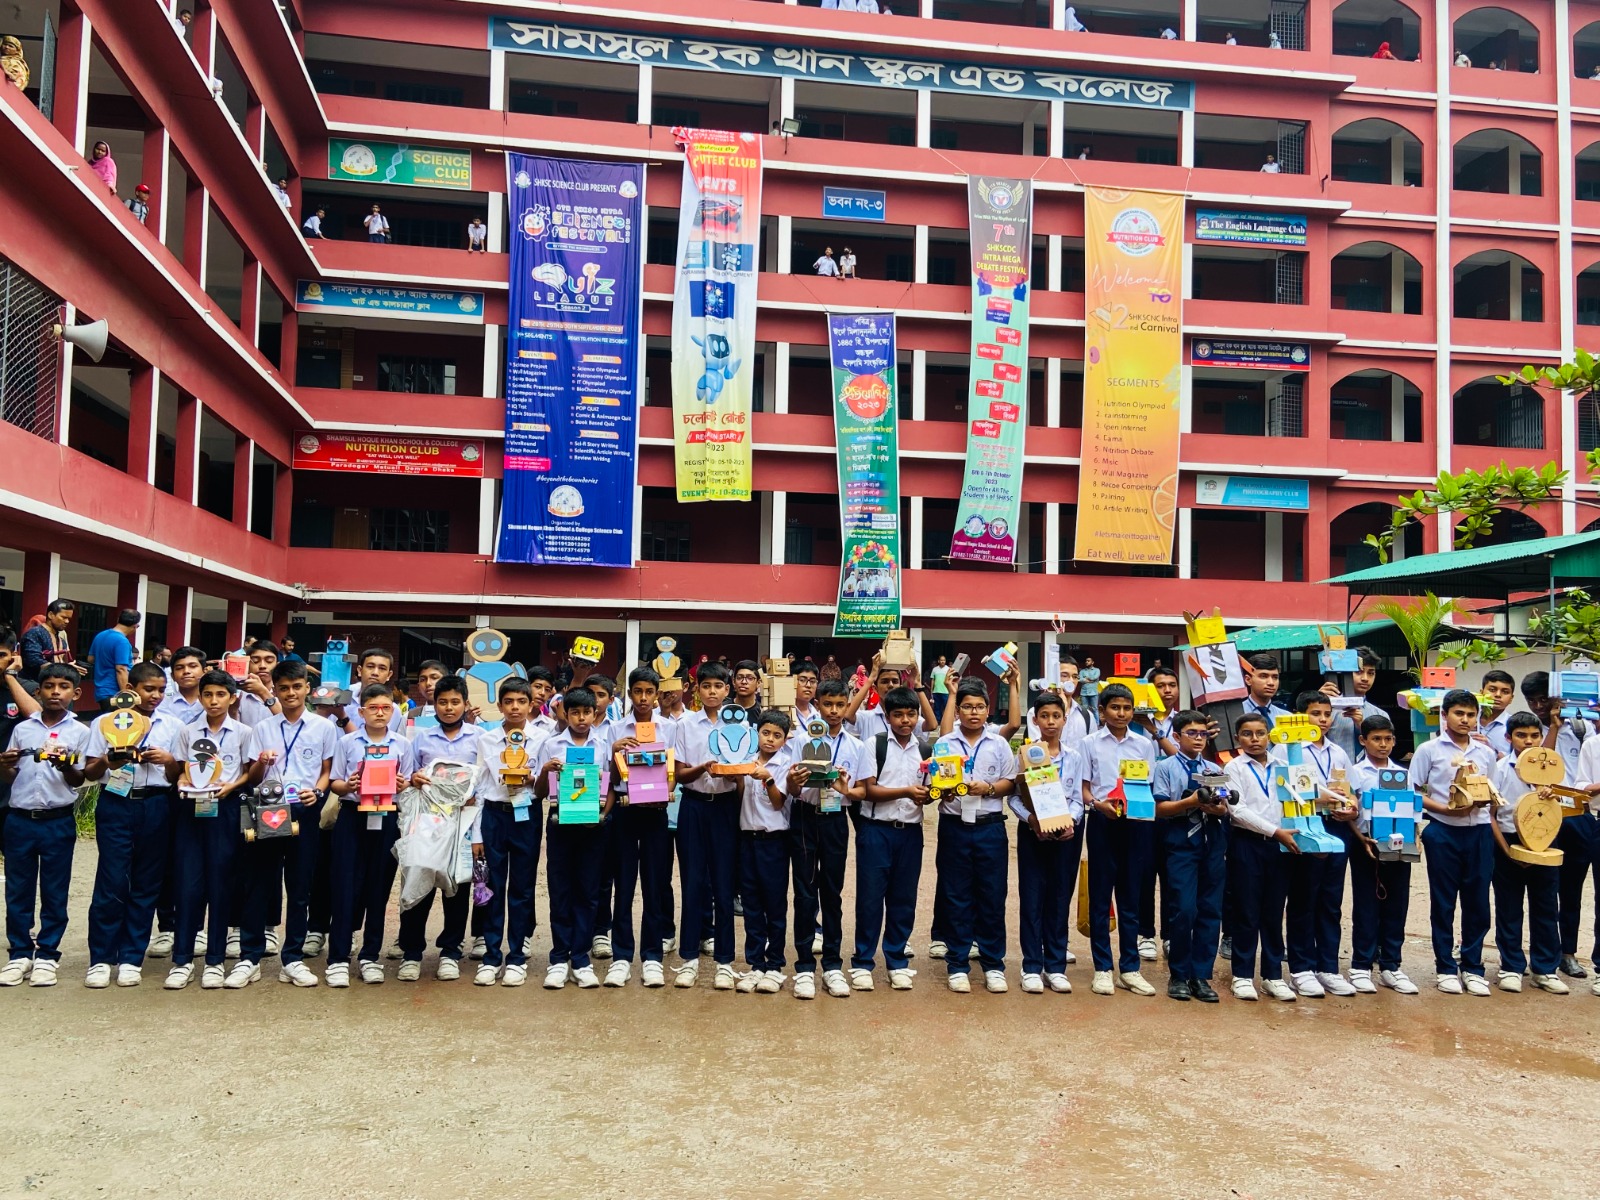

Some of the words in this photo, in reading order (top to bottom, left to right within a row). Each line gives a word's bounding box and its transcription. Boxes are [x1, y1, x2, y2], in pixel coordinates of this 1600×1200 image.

[507, 22, 675, 61] সামসুল
[681, 40, 764, 71] হক
[772, 47, 854, 77] খান
[859, 56, 945, 88] স্কুল
[950, 65, 1025, 92] এন্ড
[1033, 71, 1174, 106] কলেজ
[413, 153, 470, 168] SCIENCE
[728, 157, 757, 169] CLUB
[435, 167, 470, 180] CLUB
[534, 178, 551, 188] SHKSC
[552, 180, 574, 190] SCIENCE
[575, 181, 589, 191] CLUB
[590, 182, 617, 193] PRESENTS
[827, 195, 853, 209] ভবন
[855, 198, 883, 211] নং-৩
[552, 211, 626, 229] SCIENCE
[993, 224, 1015, 242] 7th
[1209, 220, 1223, 228] The
[1226, 220, 1252, 231] English
[1253, 222, 1287, 234] Language
[1288, 225, 1305, 234] Club
[1113, 233, 1143, 241] NUTRITION
[986, 243, 1016, 253] SHKSCDC
[982, 253, 1001, 262] INTRA
[1002, 255, 1021, 263] MEGA
[976, 262, 999, 271] DEBATE
[1000, 265, 1027, 275] FESTIVAL
[1092, 263, 1167, 293] Welcome
[361, 287, 374, 295] হক
[430, 292, 454, 300] কলেজ
[534, 291, 613, 305] LEAGUE
[1128, 313, 1161, 322] SHKSCNC
[1162, 313, 1178, 322] Intra
[1140, 322, 1179, 334] Carnival
[1106, 377, 1160, 388] SEGMENTS
[1132, 401, 1166, 410] Olympiad
[326, 434, 357, 442] SHAMSUL
[400, 438, 424, 446] SCHOOL
[345, 443, 407, 453] NUTRITION
[410, 446, 439, 455] CLUB
[1131, 448, 1155, 456] Debate
[967, 484, 982, 493] Open
[1087, 549, 1101, 558] Eat
[1128, 552, 1145, 561] Live
